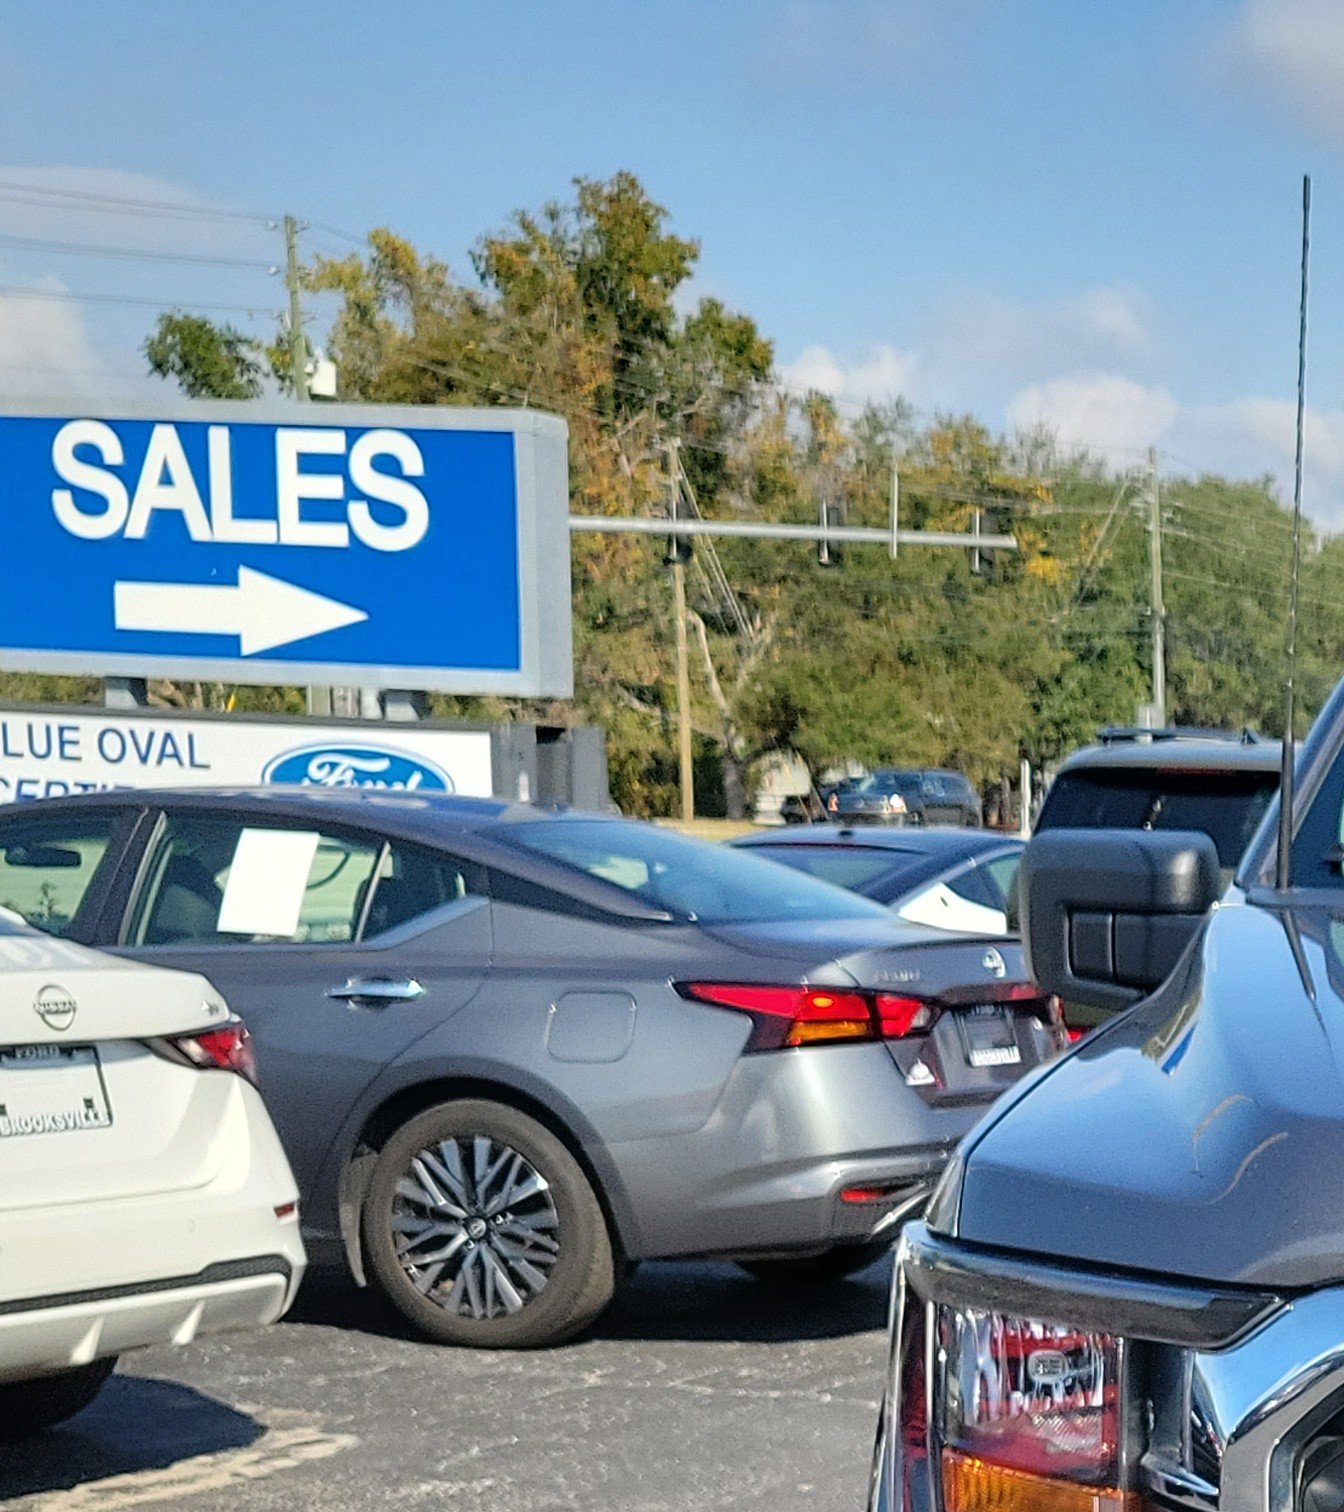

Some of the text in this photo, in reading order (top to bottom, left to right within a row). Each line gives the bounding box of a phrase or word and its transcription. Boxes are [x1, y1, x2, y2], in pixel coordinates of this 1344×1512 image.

[51, 418, 430, 552] SALES
[0, 721, 211, 769] LUE OVAL
